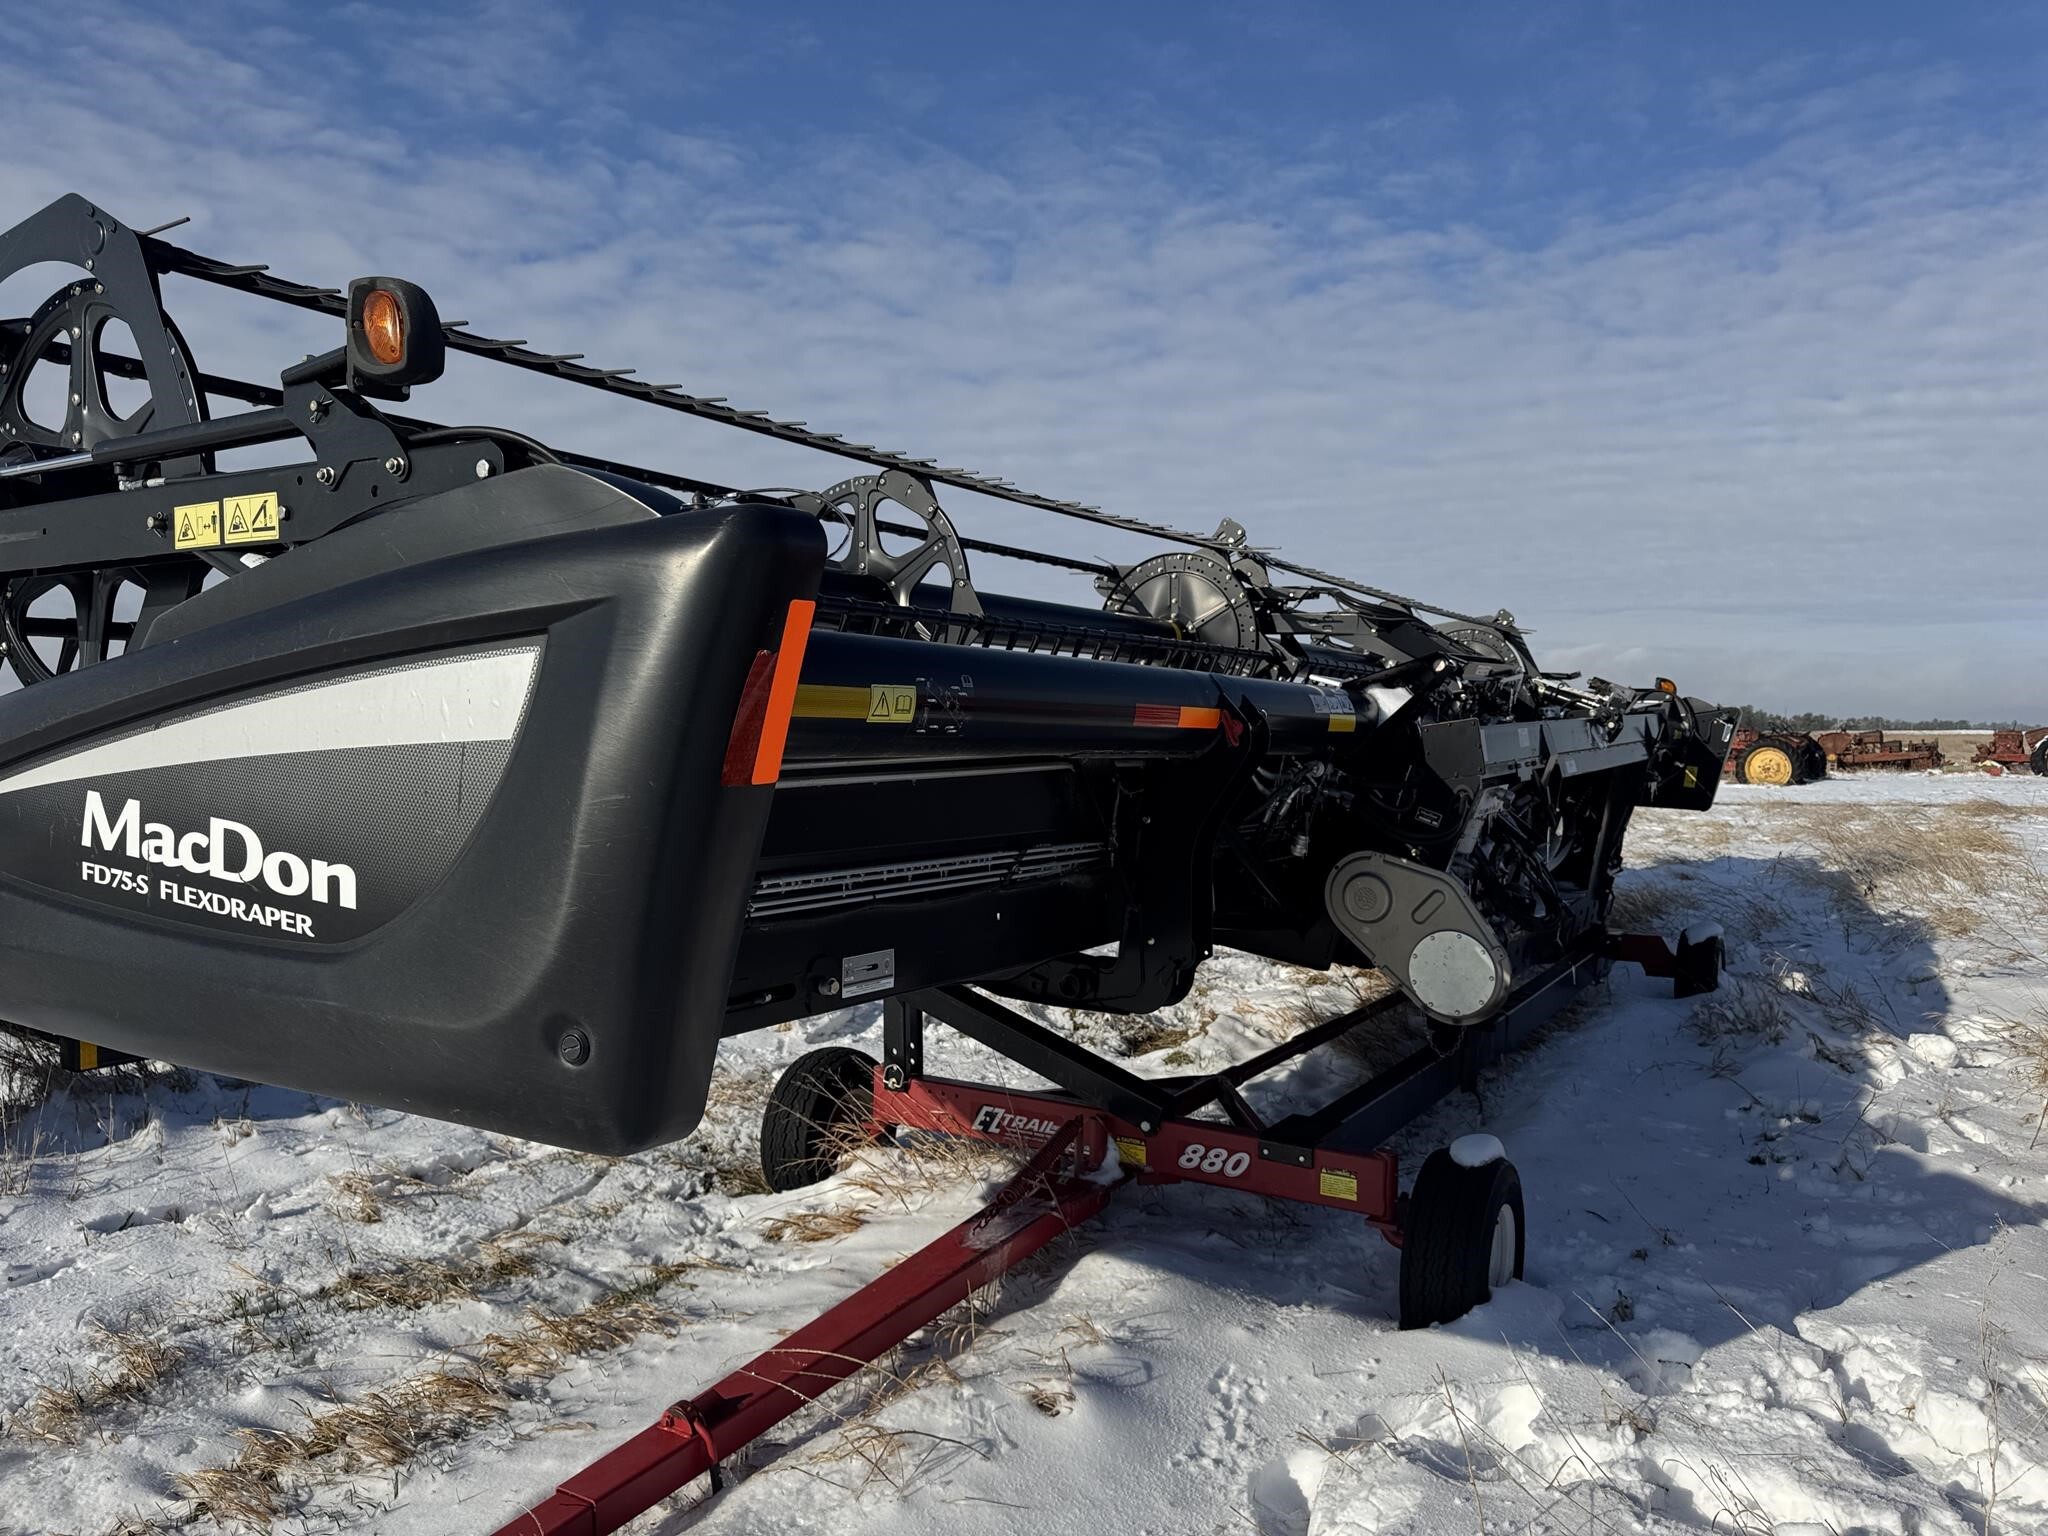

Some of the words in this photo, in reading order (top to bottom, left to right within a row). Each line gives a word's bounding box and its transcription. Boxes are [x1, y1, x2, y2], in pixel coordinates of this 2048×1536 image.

[81, 790, 357, 910] MacDon
[81, 861, 149, 895] FD75-S
[160, 879, 315, 938] FLEXDRAPER
[1178, 1143, 1250, 1178] 880
